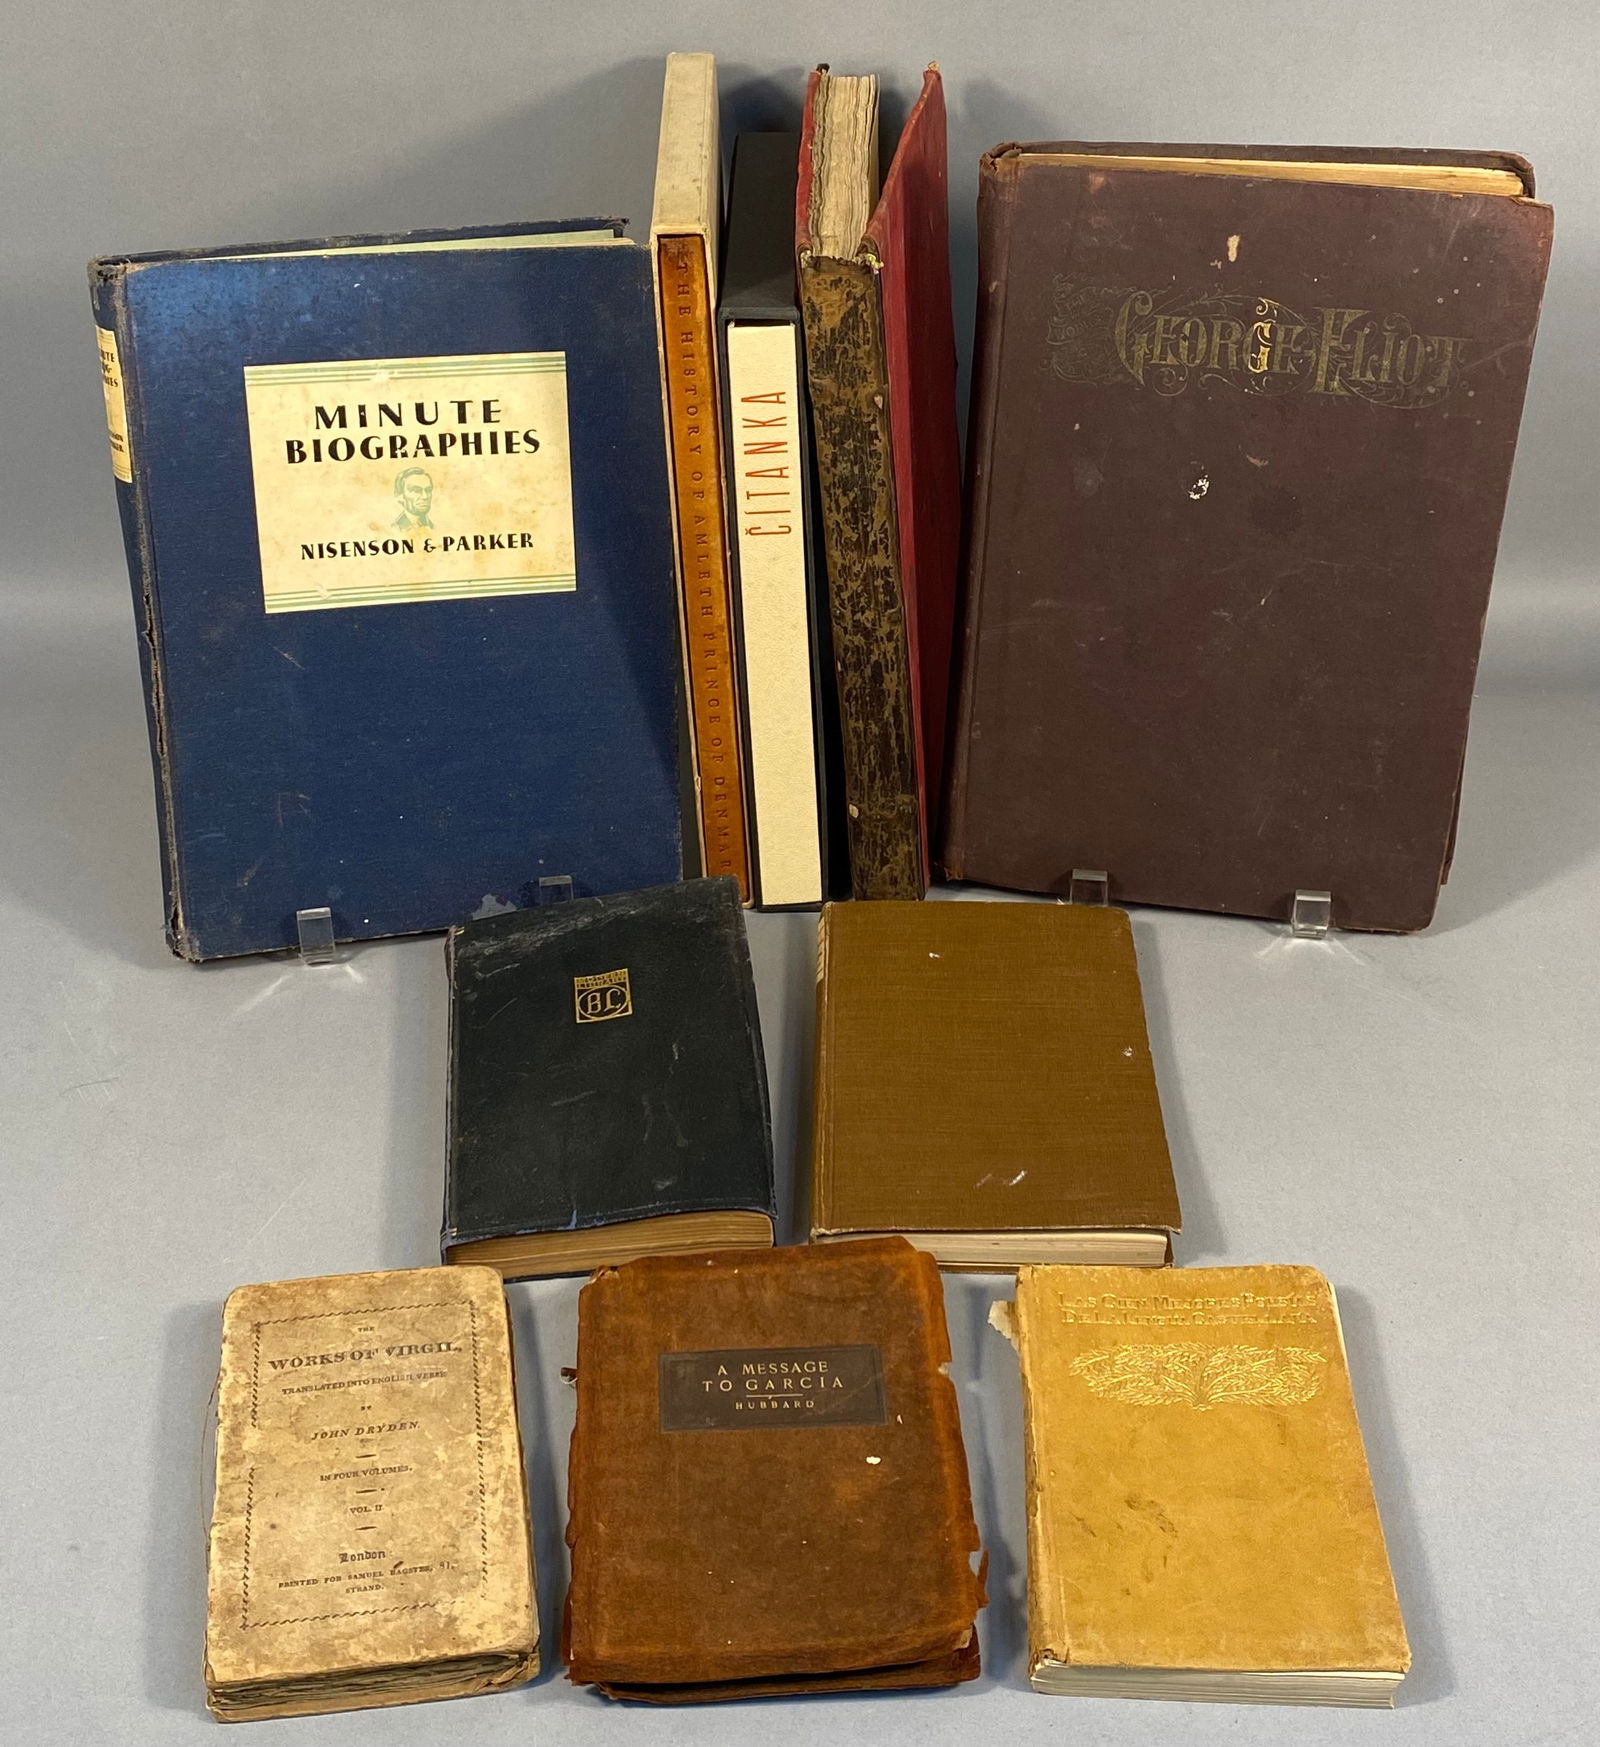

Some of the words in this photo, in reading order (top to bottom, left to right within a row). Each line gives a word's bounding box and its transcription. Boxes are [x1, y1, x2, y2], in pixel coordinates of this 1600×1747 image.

[676, 262, 691, 316] THE
[1114, 290, 1307, 387] GEORGE
[1307, 307, 1473, 397] ELIOT
[681, 331, 702, 455] HISTORY
[314, 399, 502, 430] MINUTE
[285, 429, 541, 464] BIOGRAPHIES
[691, 470, 705, 500] OF
[301, 538, 415, 560] NISENSON
[423, 536, 436, 553] &
[442, 533, 534, 553] PARKER
[694, 514, 713, 617] AMLETH
[703, 632, 721, 725] PRINCE
[711, 737, 724, 764] OF
[714, 775, 732, 873] DENMAR
[357, 1326, 375, 1334] THE
[268, 1352, 345, 1371] WORKS
[349, 1348, 379, 1361] OF
[717, 1365, 728, 1376] A
[742, 1361, 830, 1376] MESSAGE
[281, 1381, 346, 1395] TRANSLATED
[347, 1378, 370, 1388] INTO
[702, 1379, 733, 1392] TO
[745, 1376, 844, 1391] GARCIA
[735, 1400, 815, 1411] HUBBARD
[311, 1428, 350, 1440] JOHN
[319, 1474, 331, 1482] IN
[333, 1471, 360, 1481] FOUR
[278, 1578, 319, 1588] PRINTED
[324, 1576, 342, 1584] FOR
[347, 1571, 384, 1581] SAMUEL
